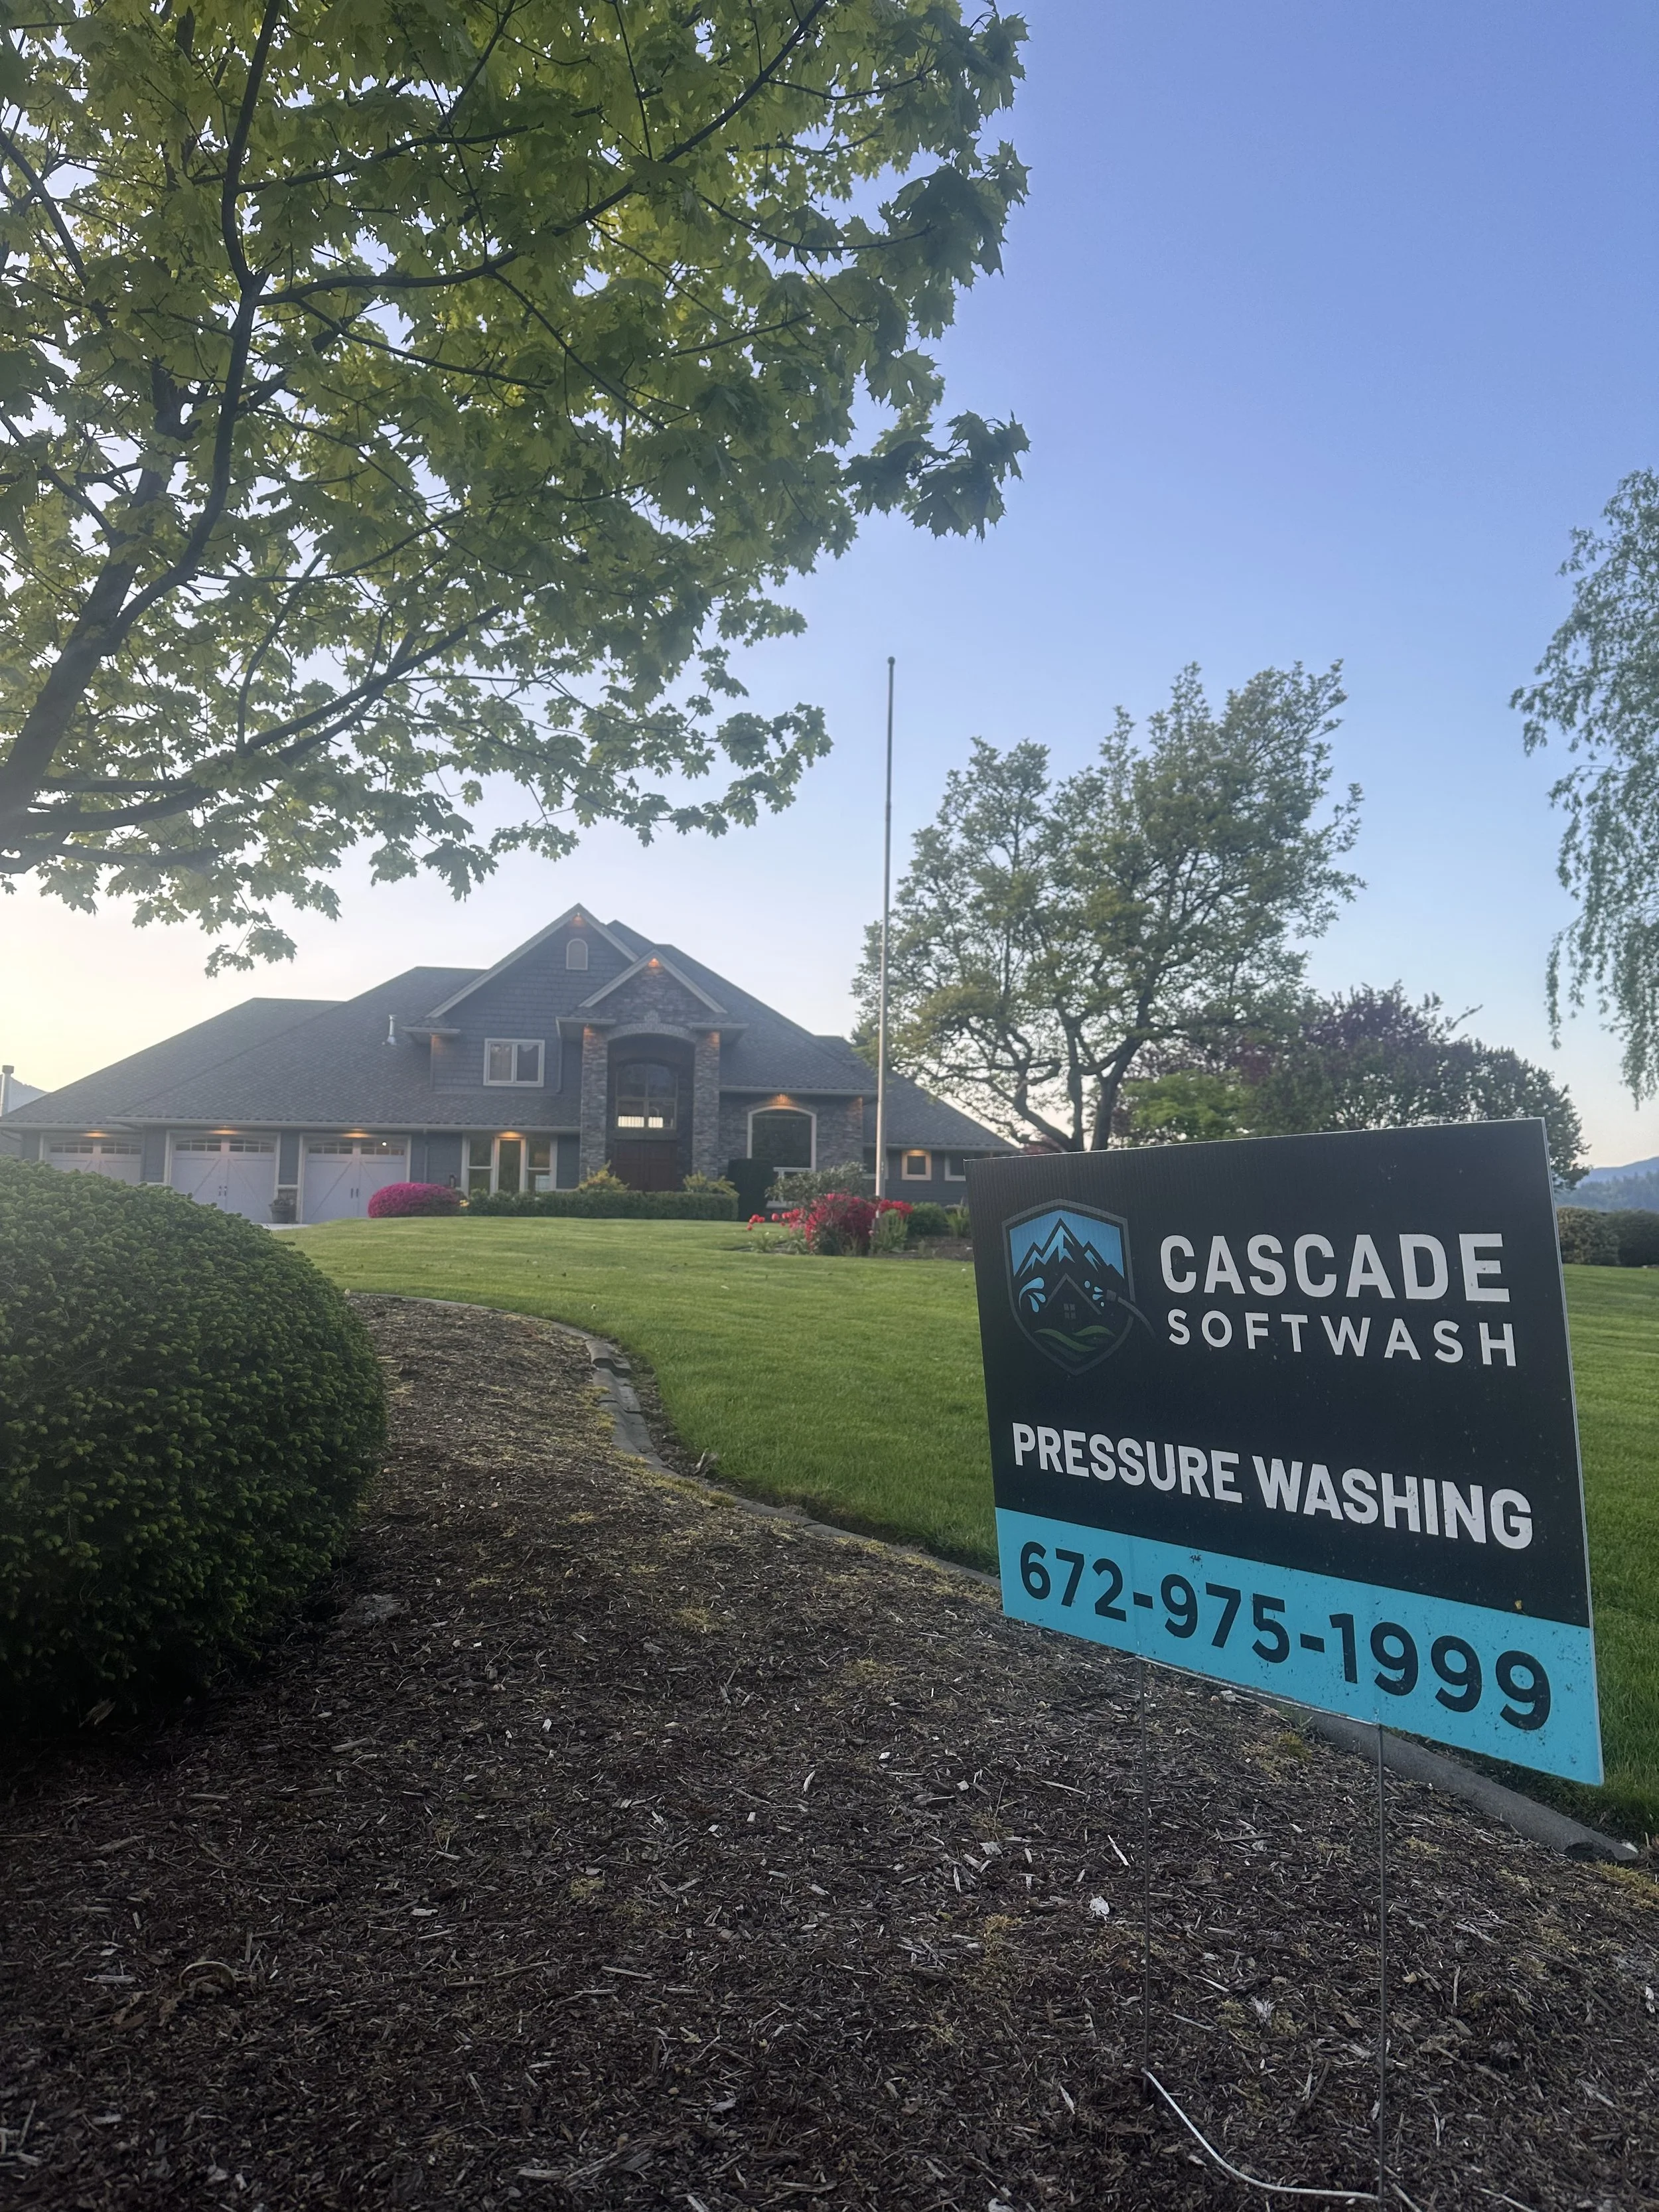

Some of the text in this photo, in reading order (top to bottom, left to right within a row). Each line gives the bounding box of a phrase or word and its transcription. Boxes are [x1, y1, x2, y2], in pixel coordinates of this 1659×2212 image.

[1161, 1234, 1510, 1302] CASCADE
[1168, 1309, 1516, 1366] SOFTWASH
[1013, 1423, 1532, 1549] PRESSURE WASHING
[1021, 1542, 1551, 1730] 672-975-1999
